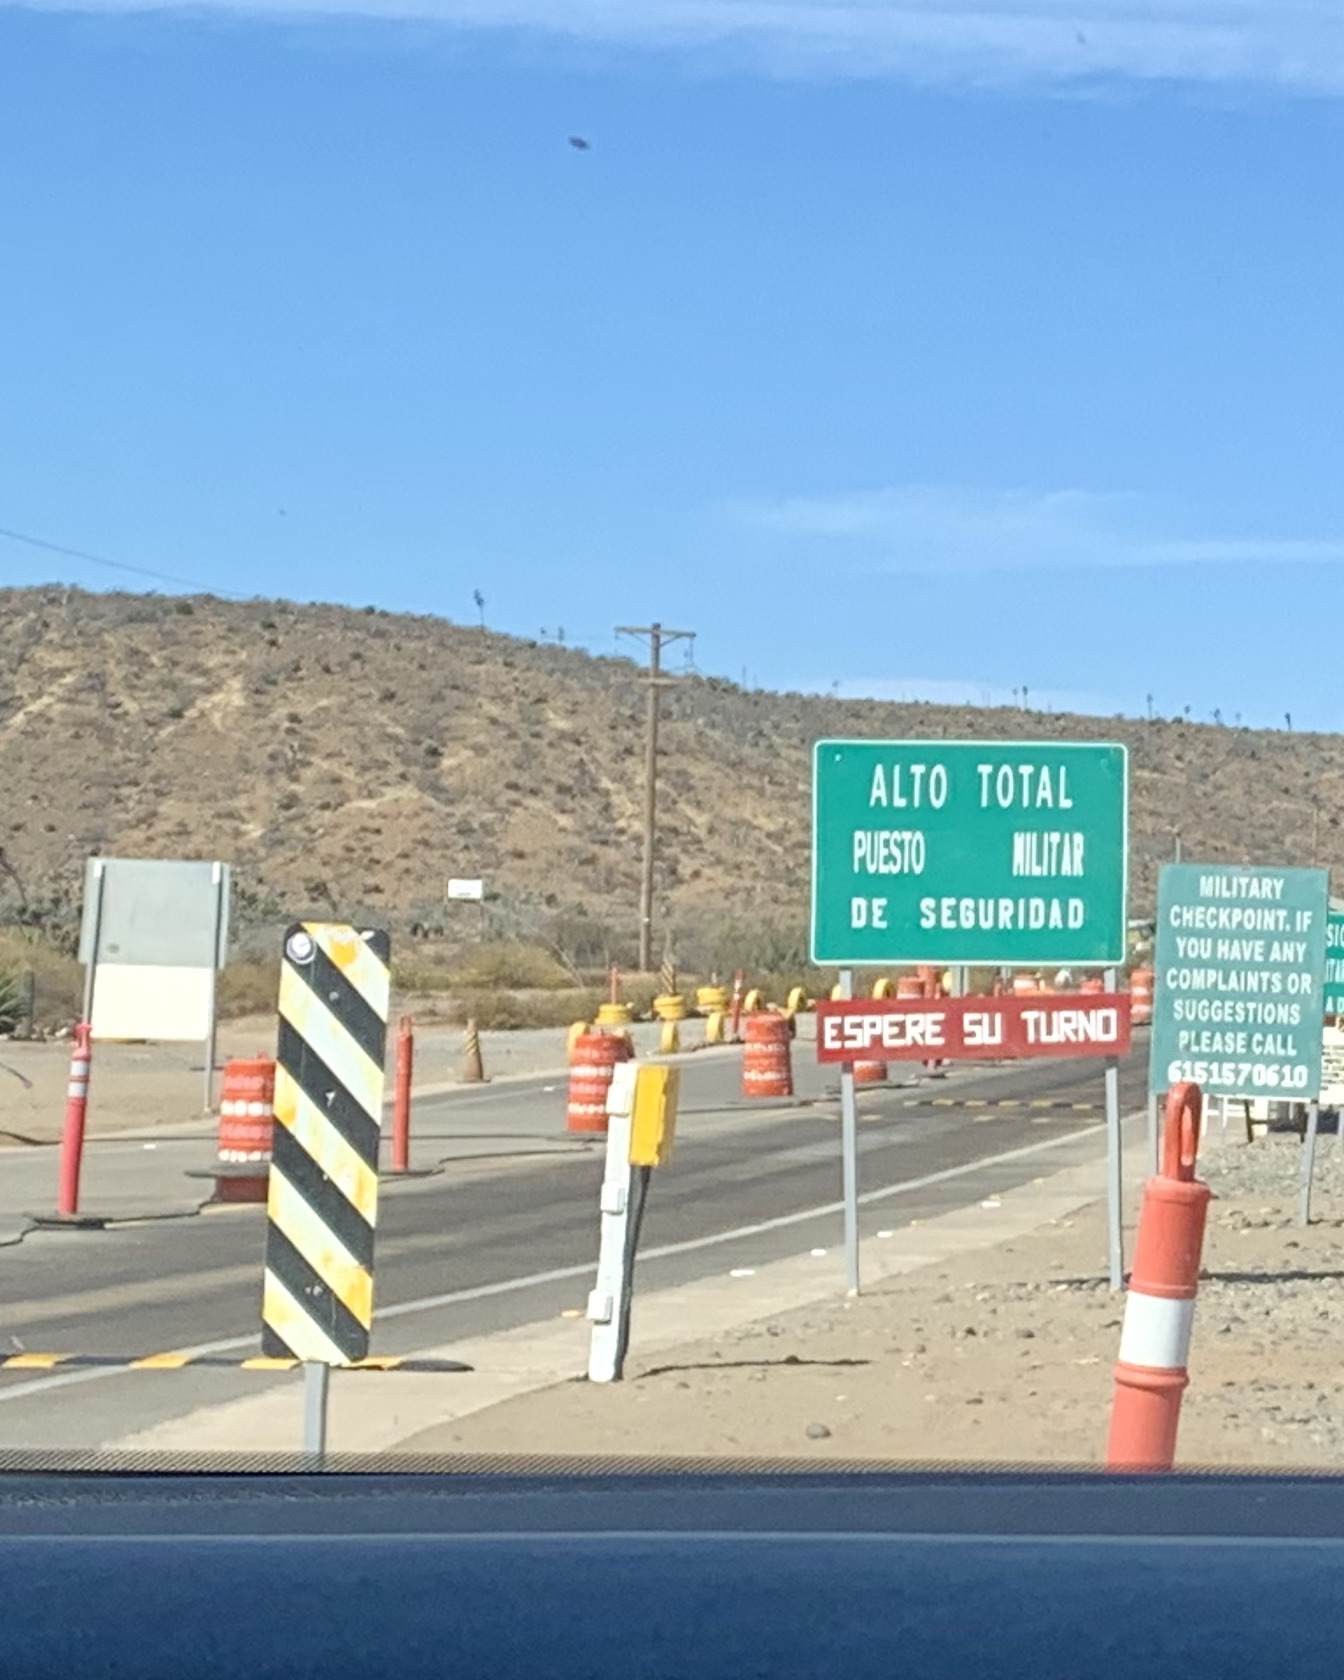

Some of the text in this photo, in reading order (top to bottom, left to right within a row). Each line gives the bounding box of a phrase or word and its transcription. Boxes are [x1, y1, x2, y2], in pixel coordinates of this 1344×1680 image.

[869, 764, 1073, 809] ALTO TOTAL
[853, 831, 1084, 876] PUESTO MILITAR
[1199, 875, 1285, 899] MILITARY
[851, 897, 1084, 929] DE SEGURIDAD
[1169, 905, 1313, 932] CHECKPOINT. IF
[1175, 937, 1307, 963] YOU HAVE ANY
[1166, 967, 1313, 995] COMPLAINTS OR
[1173, 999, 1301, 1025] SUGGESTIONS
[823, 1009, 1118, 1049] ESPERE SU TURNO
[1178, 1030, 1298, 1057] PLEASE CALL
[1167, 1059, 1309, 1088] 6151570610
